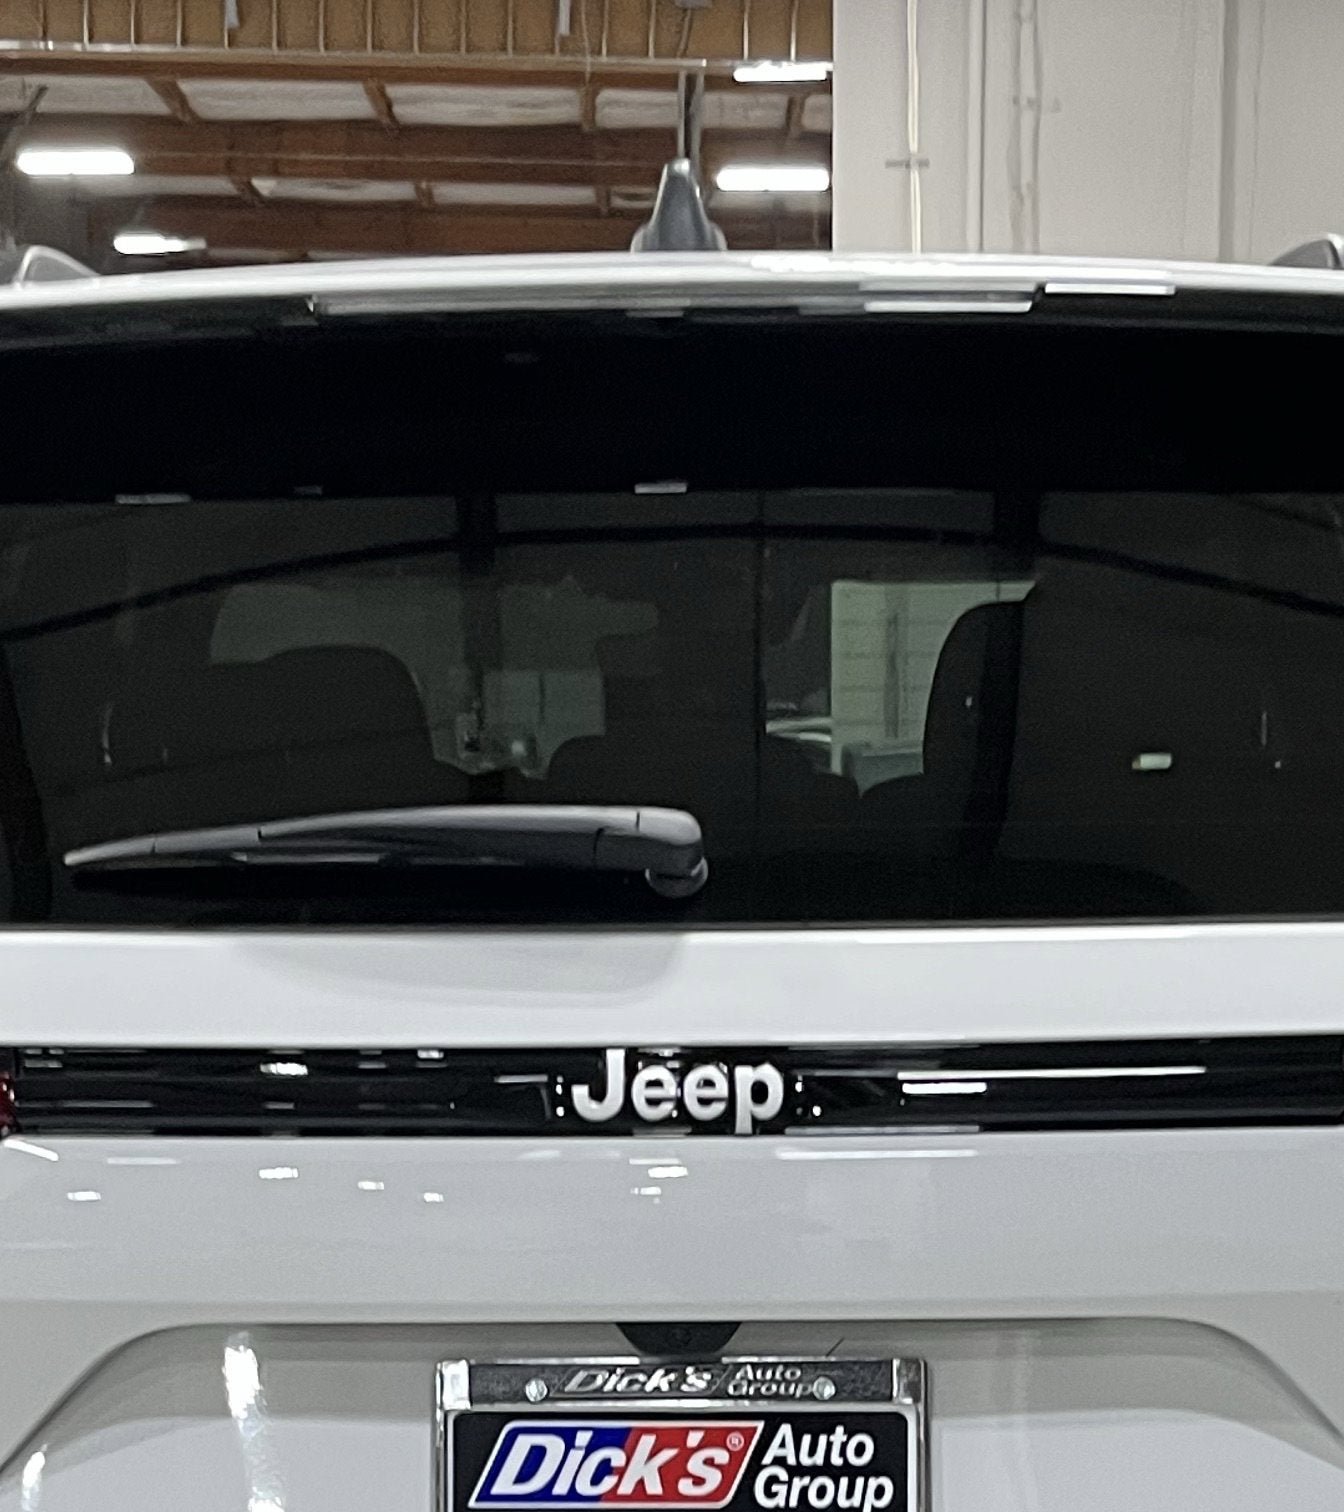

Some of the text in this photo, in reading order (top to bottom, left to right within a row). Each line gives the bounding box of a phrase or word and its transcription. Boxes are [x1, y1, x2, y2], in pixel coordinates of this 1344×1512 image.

[571, 1048, 784, 1135] Jeep
[564, 1366, 712, 1393] Dick's
[735, 1364, 802, 1381] Auto
[490, 1430, 731, 1497] Dick's
[761, 1423, 875, 1468] Auto
